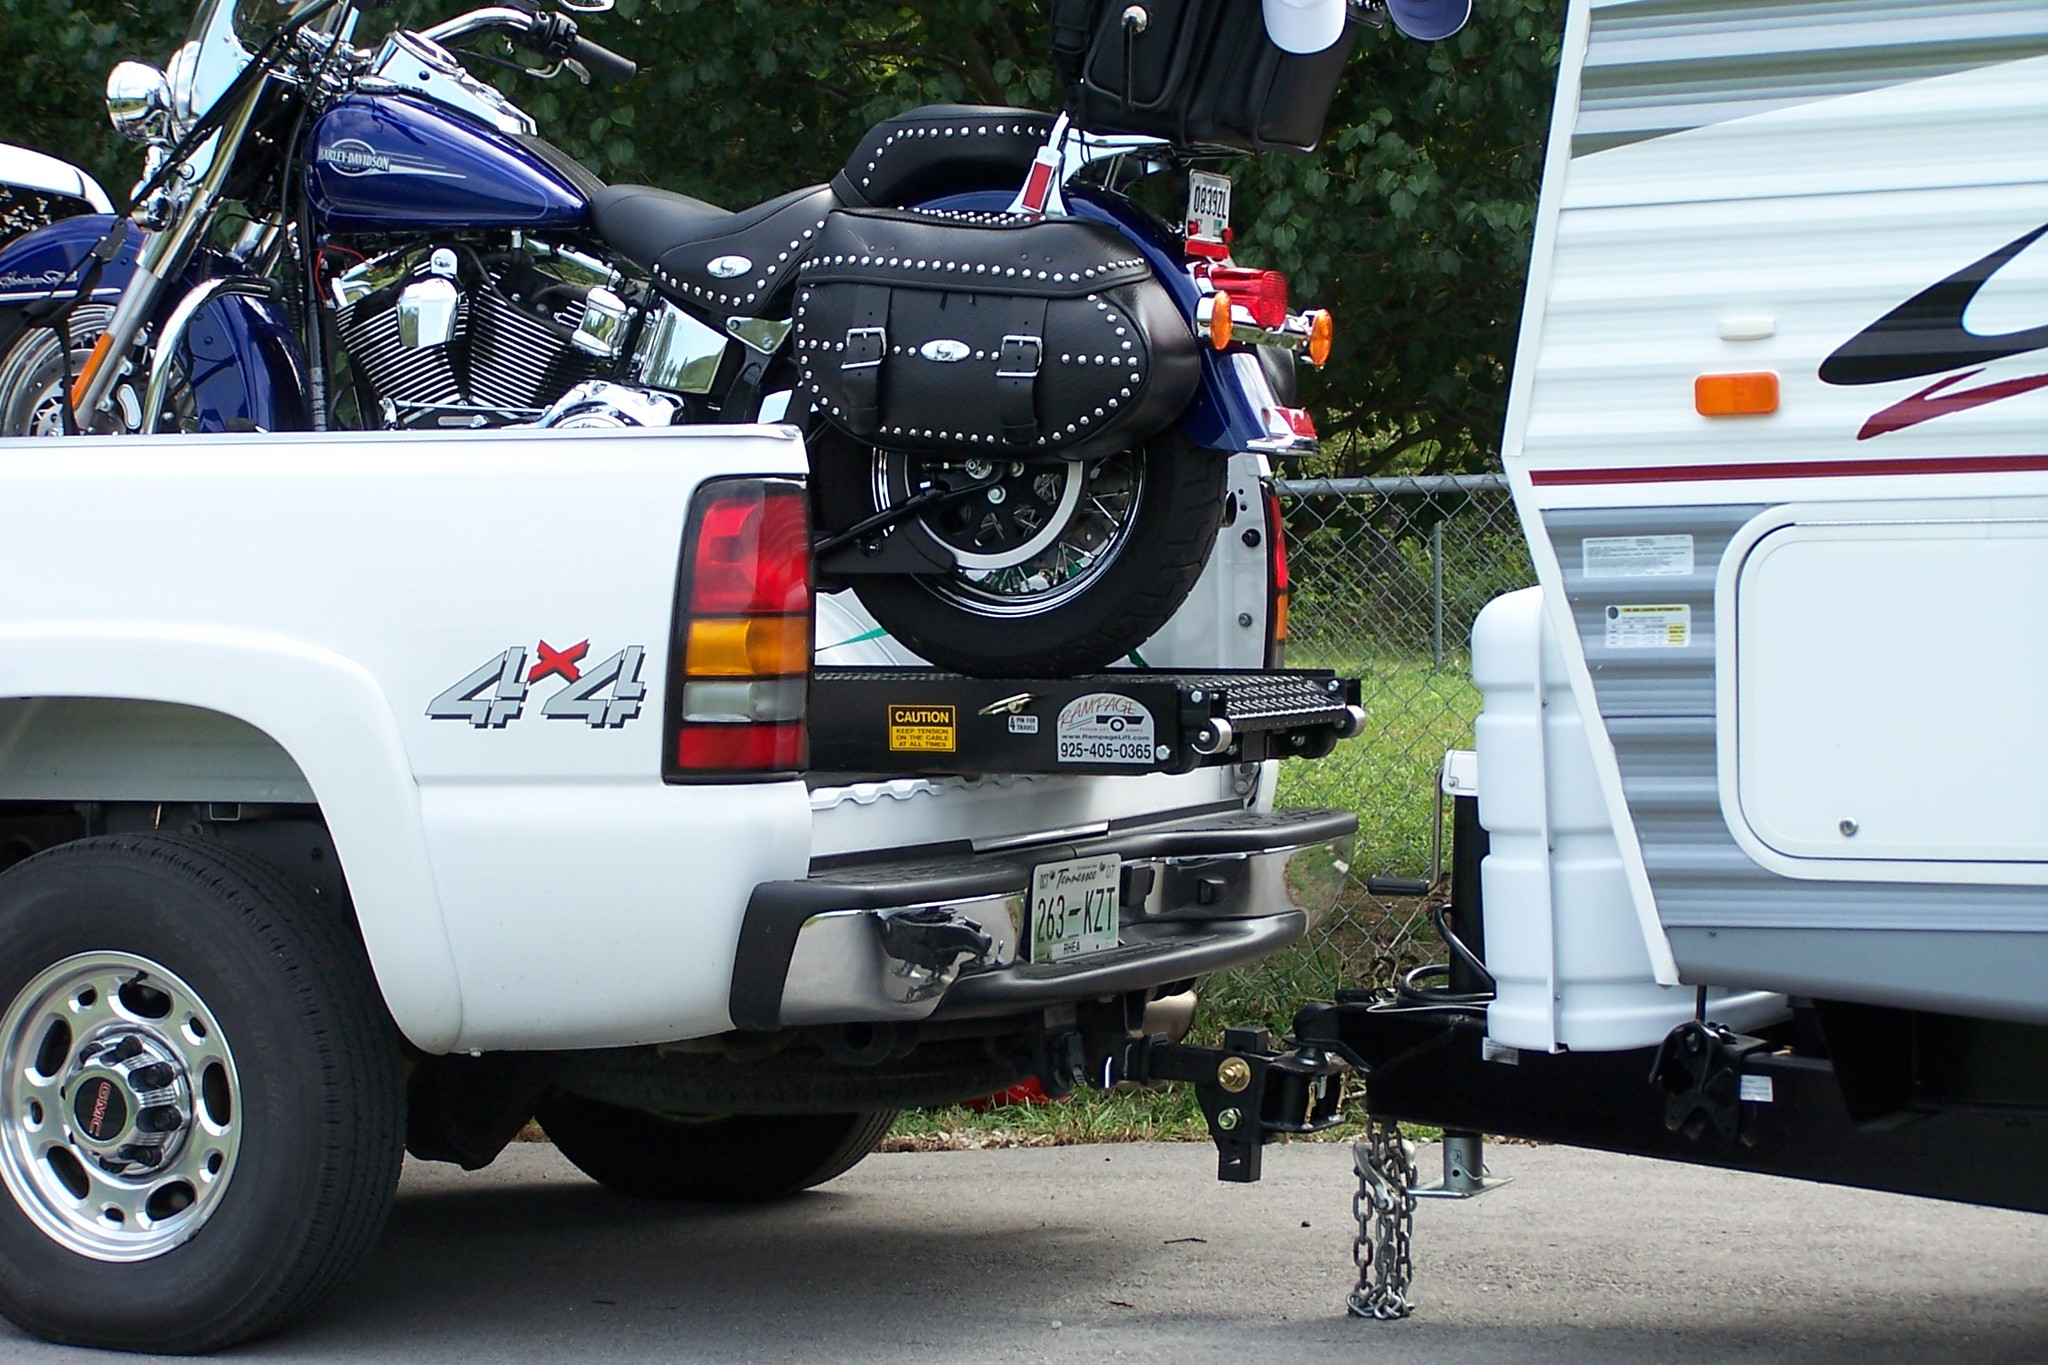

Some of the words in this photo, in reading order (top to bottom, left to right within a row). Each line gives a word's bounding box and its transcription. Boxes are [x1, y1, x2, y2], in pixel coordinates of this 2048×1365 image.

[317, 145, 390, 171] HARLEY-DAVIDSON
[895, 711, 949, 723] CAUTION
[1058, 696, 1137, 728] RAMPAGE
[1060, 742, 1151, 759] 925-405-0365
[1055, 868, 1097, 890] Tennessee
[1037, 887, 1116, 944] 263-KZT
[1063, 941, 1081, 955] RHEA
[88, 1081, 112, 1137] GMC
